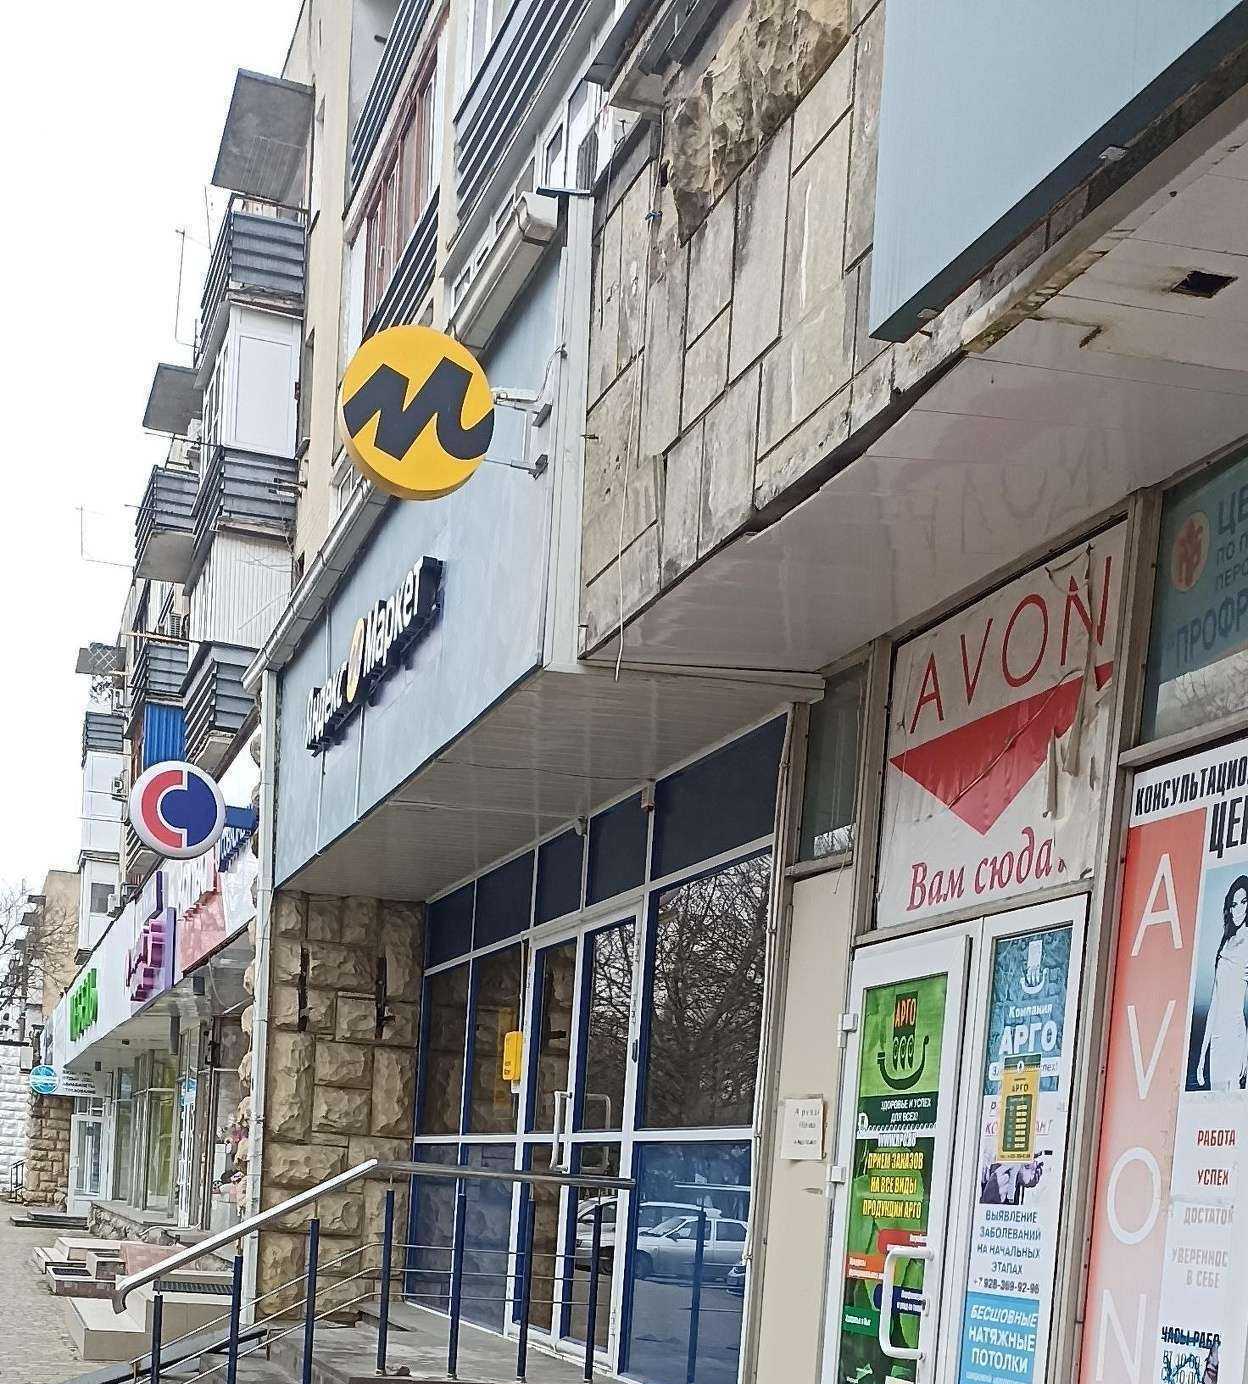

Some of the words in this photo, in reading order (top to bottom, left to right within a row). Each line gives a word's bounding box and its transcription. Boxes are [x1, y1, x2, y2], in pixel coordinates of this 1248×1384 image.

[363, 555, 424, 678] Маркет
[909, 556, 1112, 735] AVON
[1135, 755, 1248, 817] КОНСУЛЬТАЦИО
[906, 861, 965, 912] Вам
[895, 998, 917, 1029] АРГО
[1008, 1003, 1053, 1019] Компания
[999, 1020, 1058, 1055] АРГО
[881, 1099, 909, 1110] ЗДОРОВЬЕ
[914, 1098, 932, 1108] УСПЕХ
[1197, 1129, 1236, 1147] РАБОТА
[892, 1152, 924, 1170] ЗАКАЗОВ
[871, 1177, 880, 1193] НА
[880, 1177, 894, 1193] ВСЕ
[894, 1177, 917, 1195] ВИДЫ
[1197, 1168, 1230, 1186] УСПЕХ
[904, 1201, 922, 1219] АРГО
[985, 1210, 1038, 1223] ВЫЯВЛЕНИЕ
[977, 1243, 988, 1254] НА
[990, 1245, 1041, 1259] НАЧАЛЬНЫХ
[992, 1261, 1023, 1274] ЭТАПАХ
[1186, 1269, 1193, 1285] В
[1196, 1270, 1221, 1289] СЕБЕ
[970, 1304, 1039, 1327] БЕСШОВНЫЕ
[968, 1326, 1036, 1352] НАТЯЖНЫЕ
[972, 1348, 1028, 1374] ПОТОЛКИ
